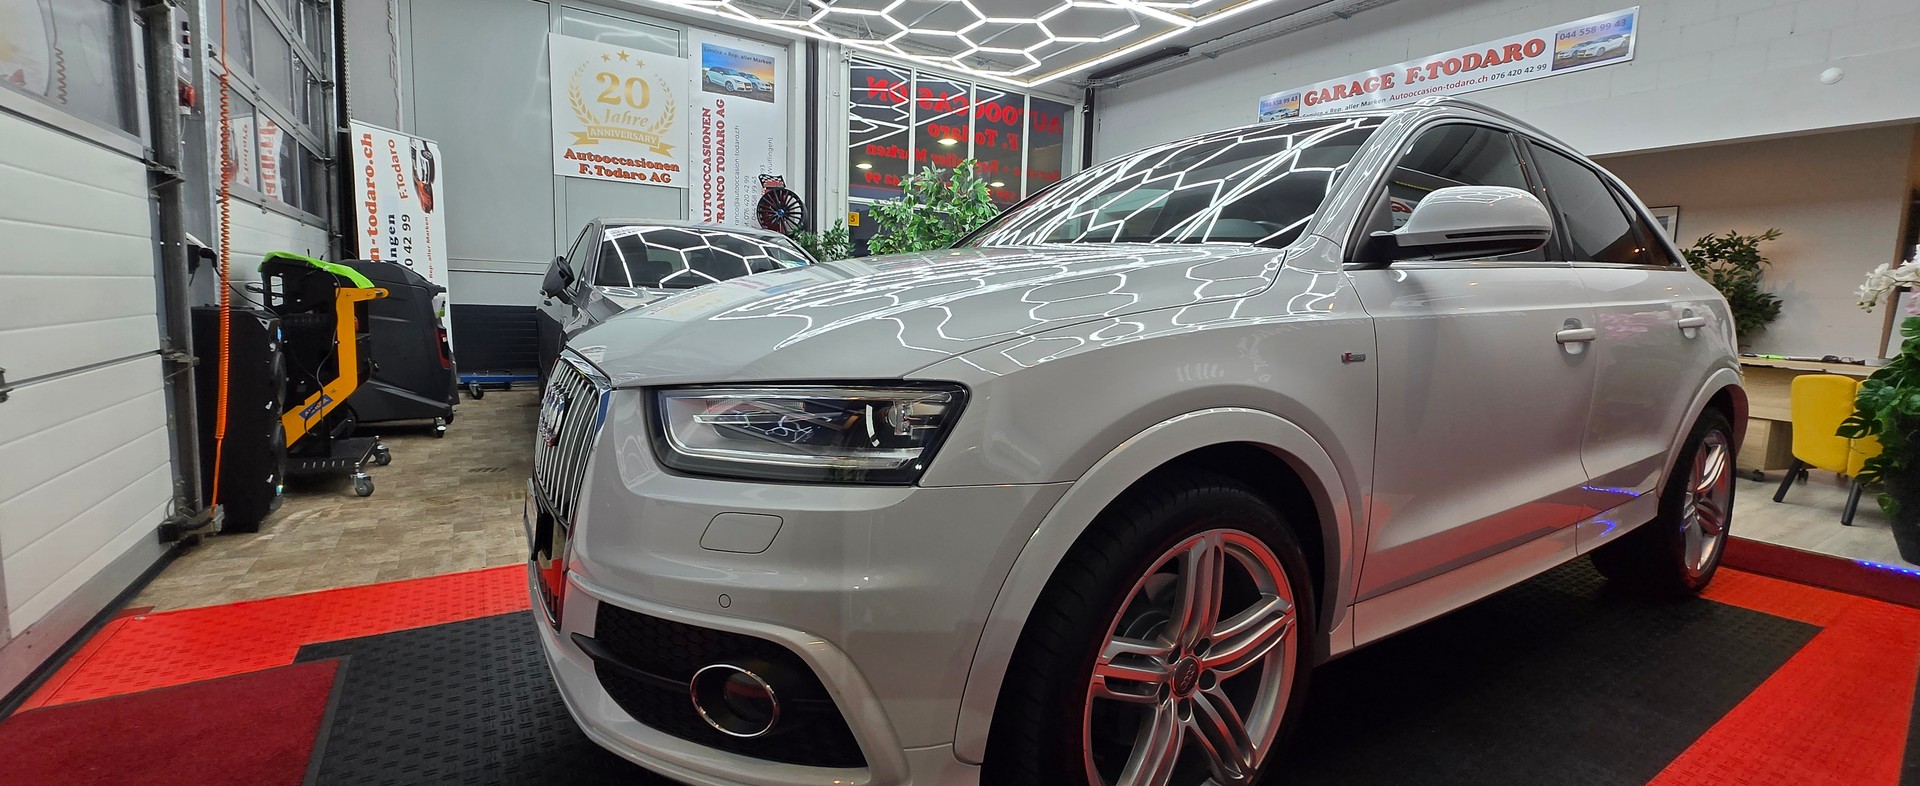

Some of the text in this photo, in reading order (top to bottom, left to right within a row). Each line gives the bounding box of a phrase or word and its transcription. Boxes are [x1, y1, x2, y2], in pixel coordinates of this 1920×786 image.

[1560, 18, 1627, 40] 044 558 99 43
[753, 57, 773, 65] Marken
[1303, 38, 1546, 107] GARAGE F.TODARO
[596, 71, 651, 110] 20
[1345, 103, 1360, 111] aller
[1361, 98, 1387, 108] Marken
[1389, 75, 1488, 102] Autooccasion-todaro.ch
[1491, 72, 1505, 80] 076
[1507, 69, 1522, 77] 420
[1537, 63, 1547, 71] 99
[604, 108, 649, 127] Jahre
[716, 99, 725, 118] AG
[590, 128, 657, 144] ANNIVERSARY
[716, 120, 725, 173] TODARO
[387, 139, 409, 199] F.Todaro
[563, 148, 680, 172] Autooccasionen
[579, 162, 672, 184] F. Todaro AG
[401, 214, 411, 231] 99
[402, 236, 412, 254] 42
